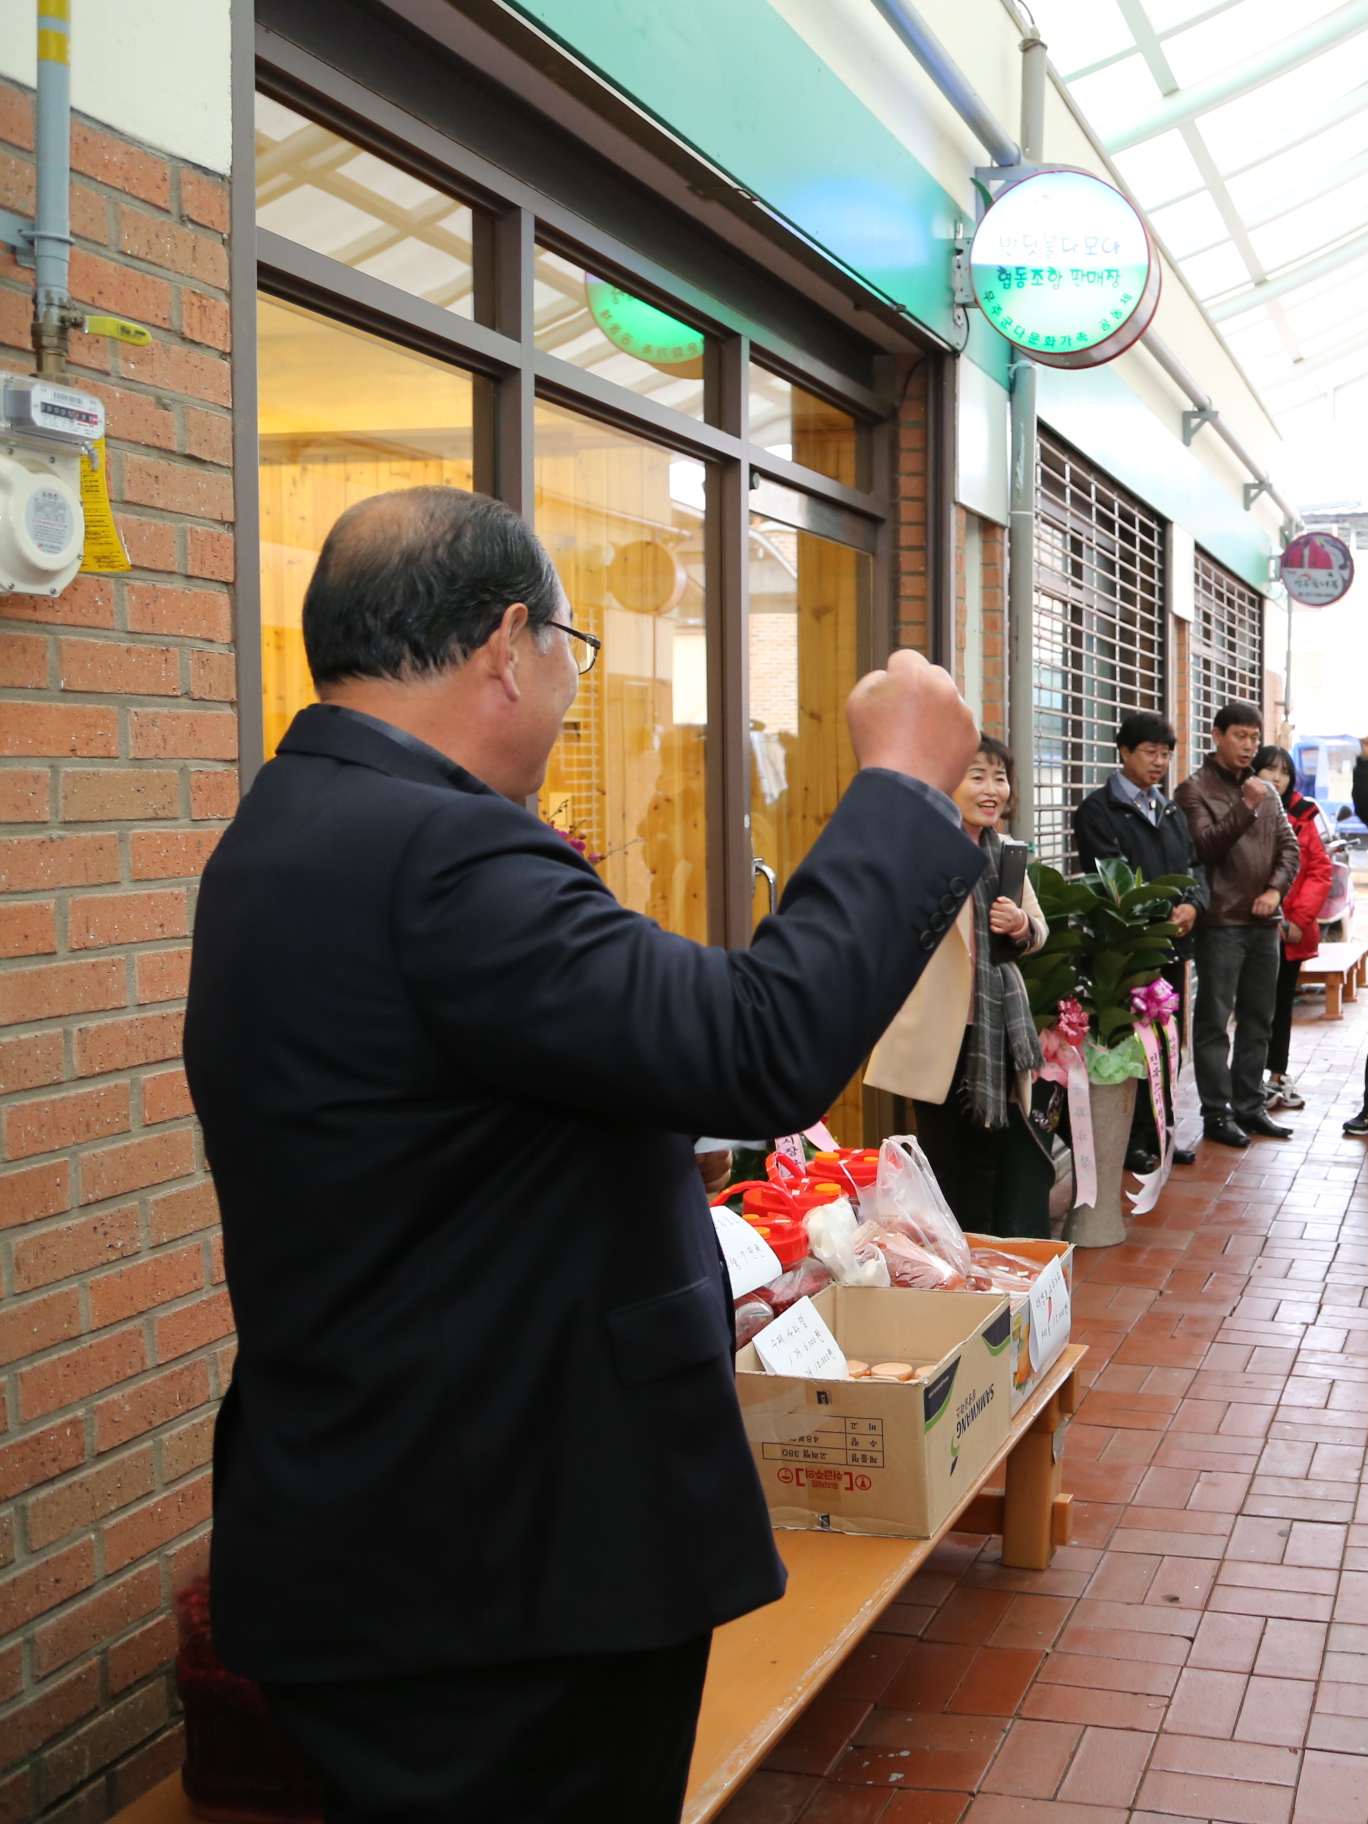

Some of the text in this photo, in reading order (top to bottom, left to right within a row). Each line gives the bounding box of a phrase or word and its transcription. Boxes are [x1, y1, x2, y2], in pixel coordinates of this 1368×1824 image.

[997, 265, 1121, 290] 협동조합 판매장
[956, 1383, 995, 1439] SAMKWANG
[781, 1448, 800, 1458] 380
[852, 1453, 878, 1464] 제품명
[805, 1468, 843, 1481] 취급주의
